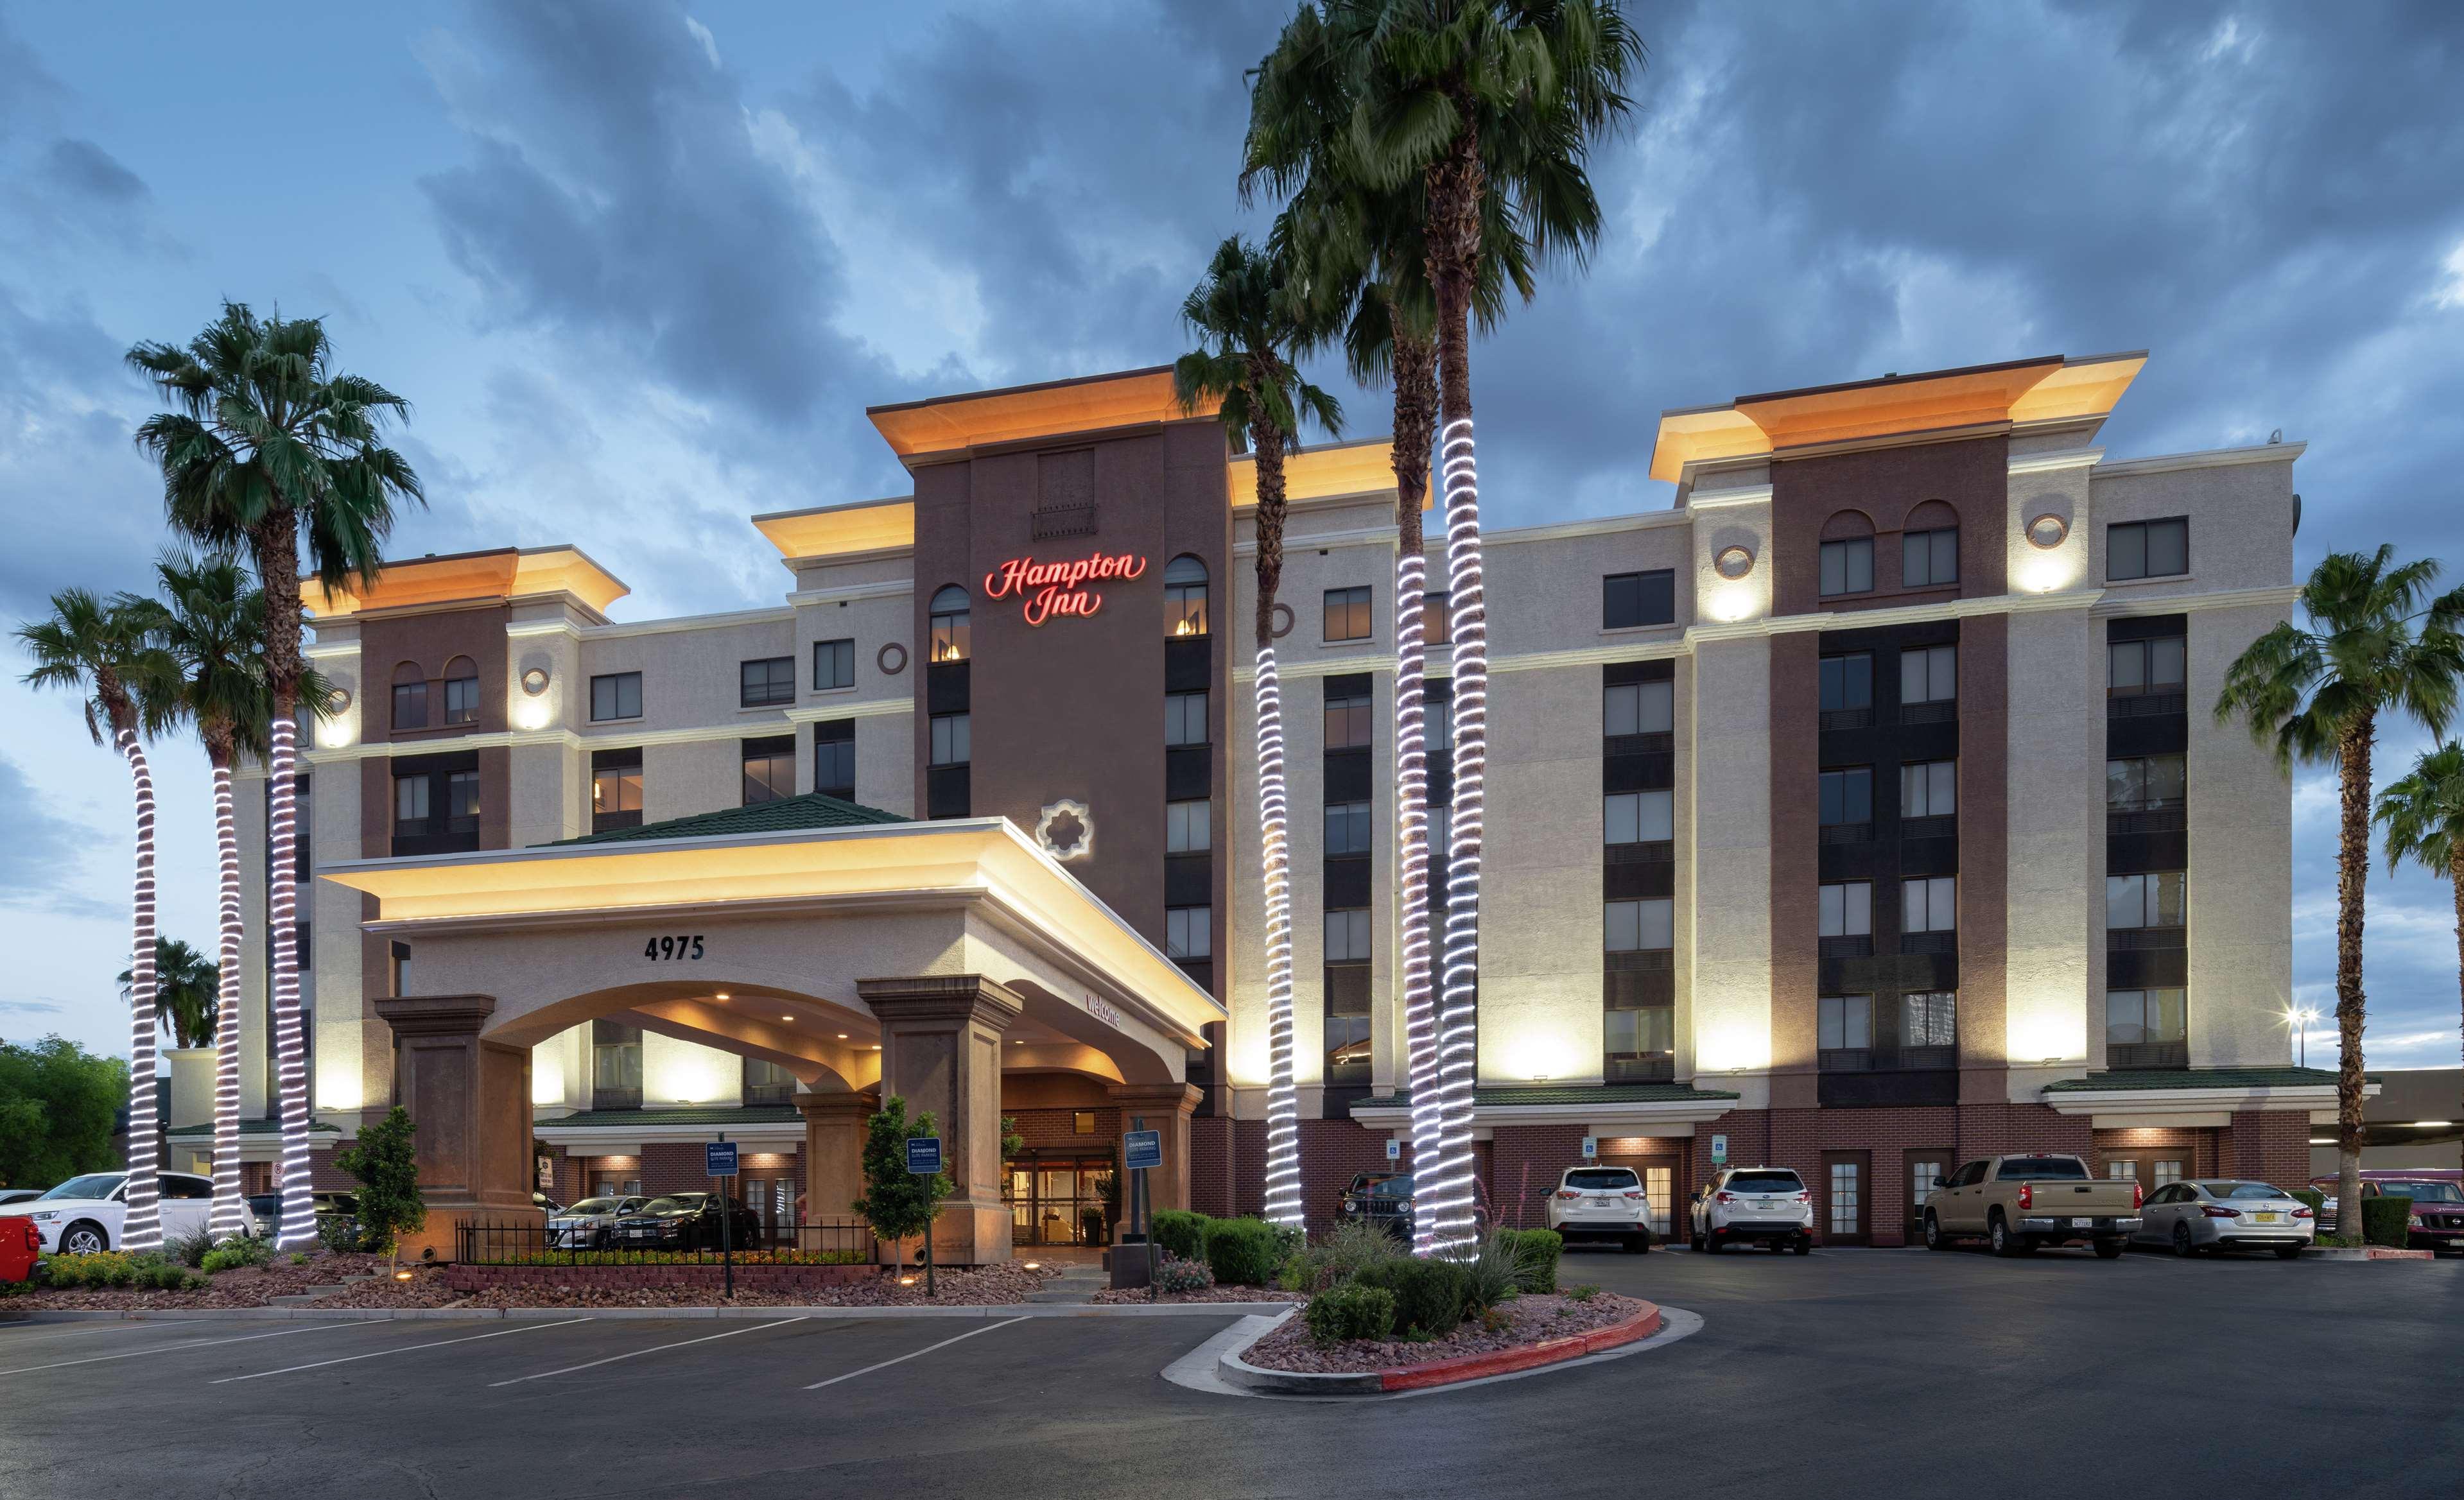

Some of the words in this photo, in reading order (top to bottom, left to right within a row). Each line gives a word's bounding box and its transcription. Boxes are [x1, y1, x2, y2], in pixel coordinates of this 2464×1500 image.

[984, 551, 1147, 600] Hampton
[1024, 585, 1102, 626] Inn
[645, 935, 704, 961] 4975
